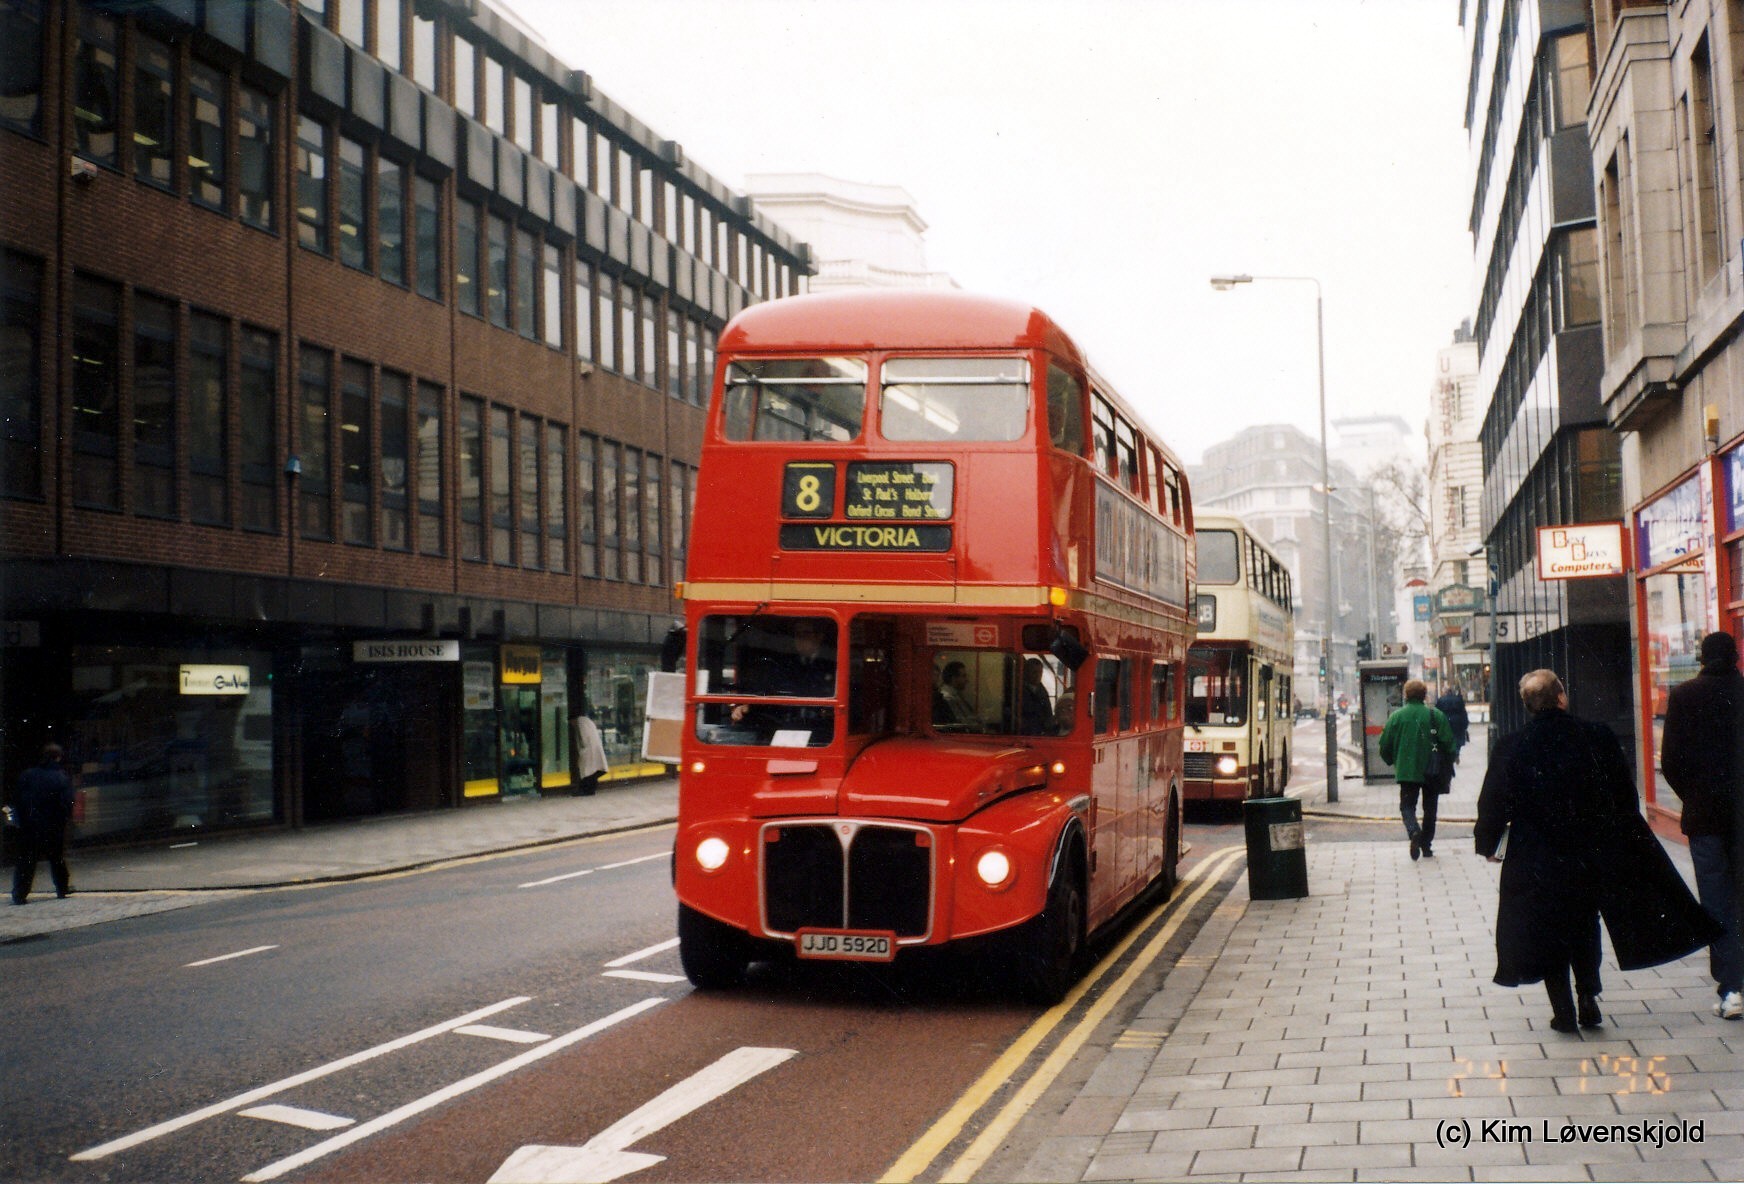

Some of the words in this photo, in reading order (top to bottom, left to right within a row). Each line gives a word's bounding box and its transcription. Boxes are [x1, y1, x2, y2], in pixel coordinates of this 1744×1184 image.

[857, 471, 890, 486] Liverpool
[891, 471, 915, 484] Street
[796, 475, 821, 511] 8
[847, 504, 872, 517] Oxford
[874, 504, 895, 517] Circus
[902, 504, 922, 518] Bond
[814, 527, 920, 547] VICTORIA
[1551, 562, 1614, 573] Computers
[369, 645, 395, 658] ISIS
[398, 644, 444, 657] HOUSE
[803, 936, 838, 951] JJD
[842, 937, 888, 954] 592D
